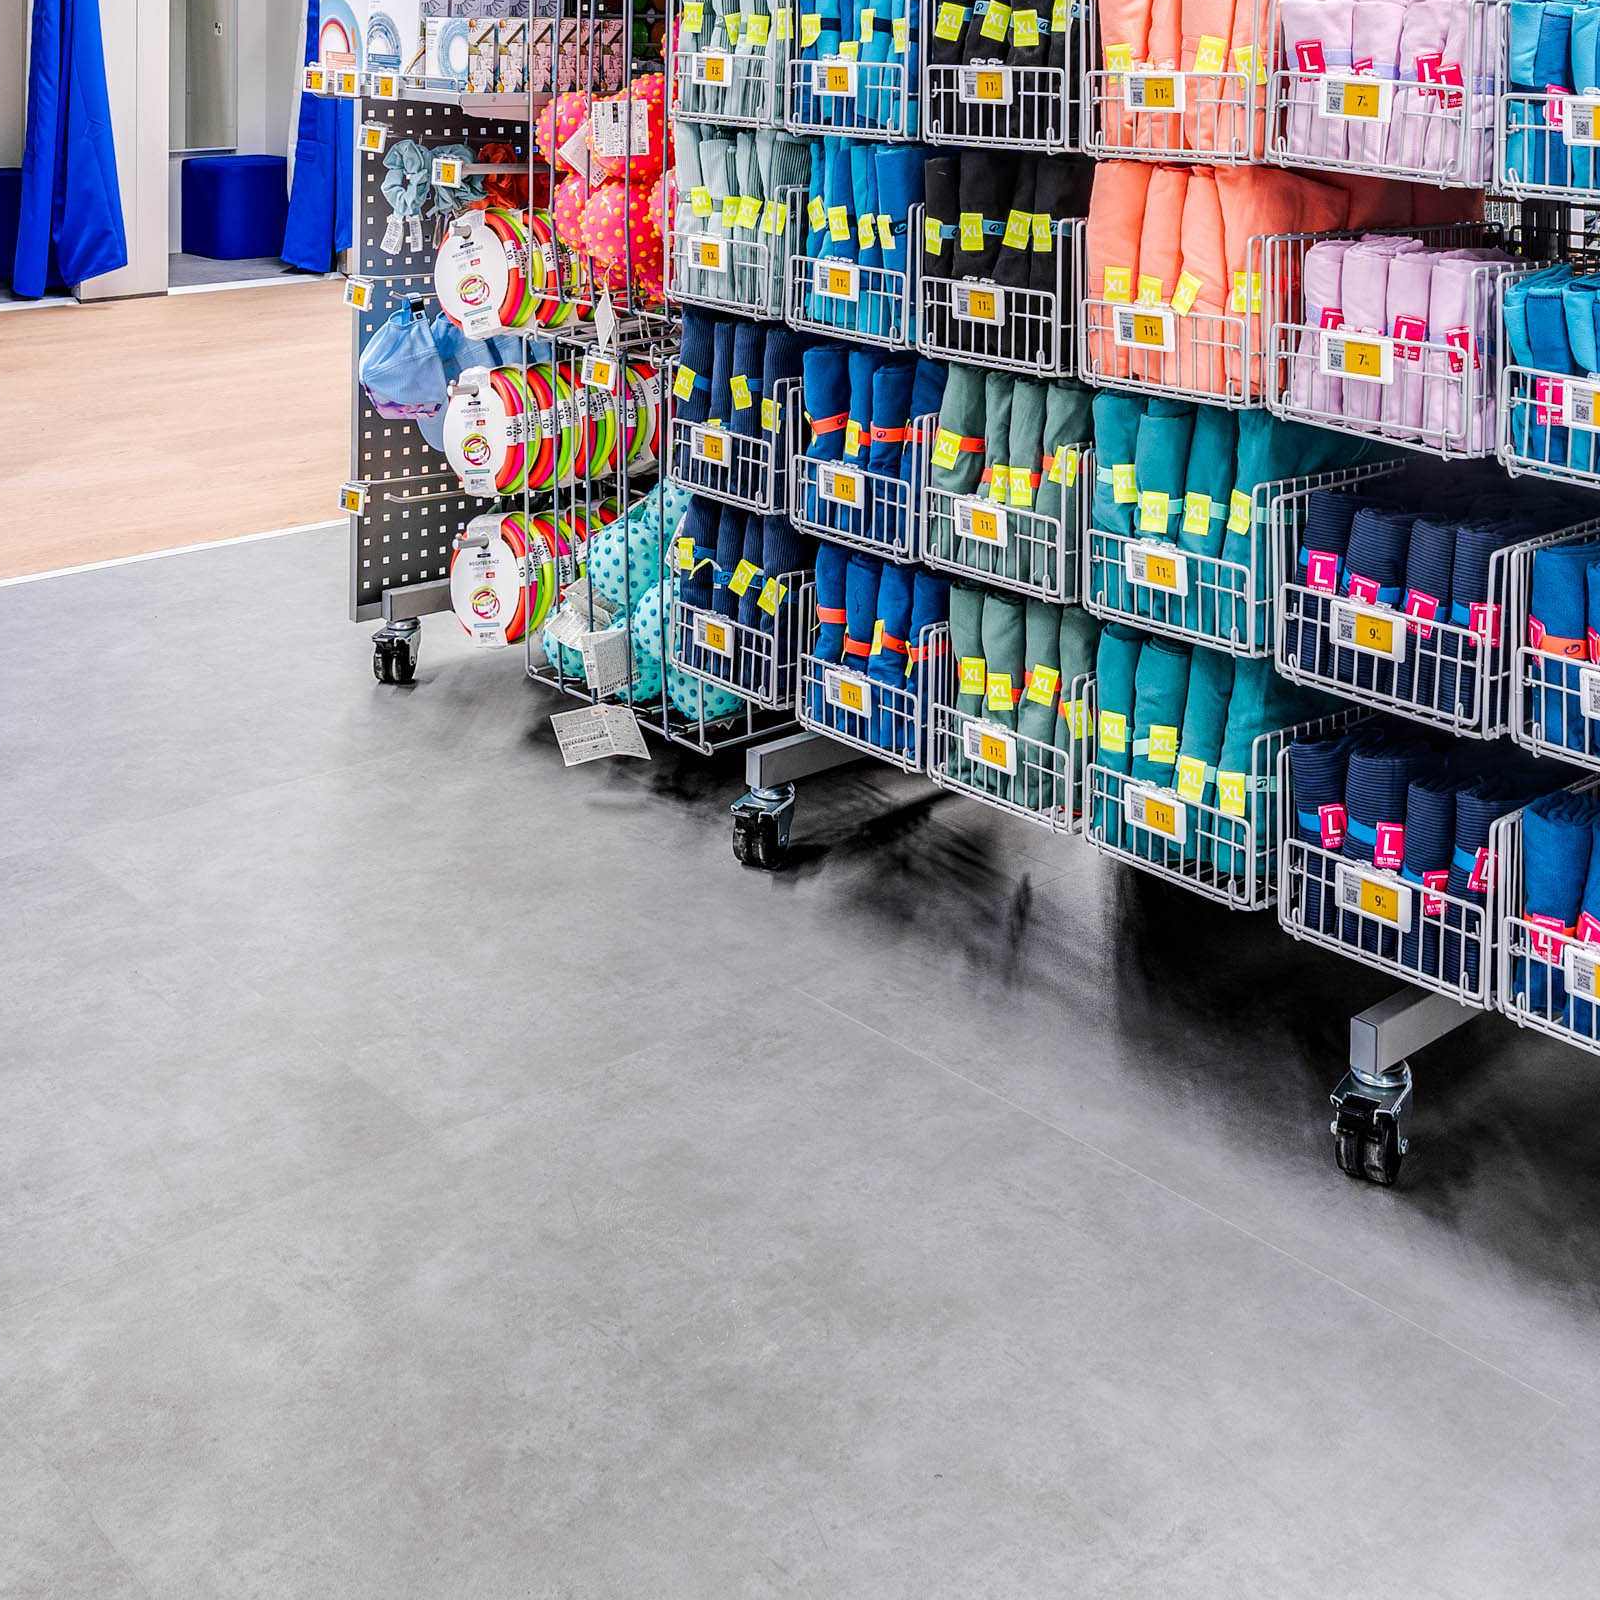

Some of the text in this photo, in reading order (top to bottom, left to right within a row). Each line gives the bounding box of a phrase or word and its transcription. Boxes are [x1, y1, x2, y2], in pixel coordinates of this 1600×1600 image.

[686, 11, 699, 23] XL
[941, 12, 958, 30] XL
[988, 12, 1006, 29] XL
[750, 23, 766, 38] XL
[804, 23, 818, 37] XL
[1016, 20, 1035, 35] XL
[1110, 56, 1129, 71] XL
[1201, 48, 1220, 65] XL
[1303, 50, 1319, 71] L
[1424, 62, 1437, 84] L
[694, 195, 709, 208] XL
[741, 205, 757, 220] XL
[812, 209, 825, 222] XL
[831, 217, 847, 232] XL
[861, 223, 874, 238] XL
[964, 224, 981, 238] XL
[1010, 222, 1026, 237] XL
[1035, 224, 1049, 238] XL
[927, 227, 940, 241] XL
[506, 250, 514, 261] 10
[545, 252, 552, 262] 10
[1107, 279, 1129, 294] XL
[1177, 286, 1194, 305] XL
[678, 374, 691, 391] XL
[734, 383, 748, 400] XL
[579, 396, 586, 407] 10
[627, 407, 634, 419] 20
[506, 425, 512, 437] 10
[543, 418, 549, 429] 10
[847, 430, 859, 446] XL
[938, 439, 956, 457] XL
[1013, 476, 1029, 492] XL
[1117, 473, 1134, 490] XL
[1145, 503, 1165, 519] XL
[1188, 503, 1207, 520] XL
[1233, 503, 1248, 521] XL
[680, 548, 691, 561] XL
[518, 567, 526, 578] 10
[735, 570, 748, 587] XL
[1314, 561, 1329, 584] L
[965, 668, 982, 682] XL
[1034, 672, 1052, 690] XL
[991, 684, 1009, 698] XL
[1104, 722, 1123, 737] XL
[1154, 738, 1174, 752] XL
[1182, 770, 1201, 789] XL
[1222, 784, 1243, 802] XL
[1327, 814, 1341, 834] L
[1383, 832, 1398, 855] L
